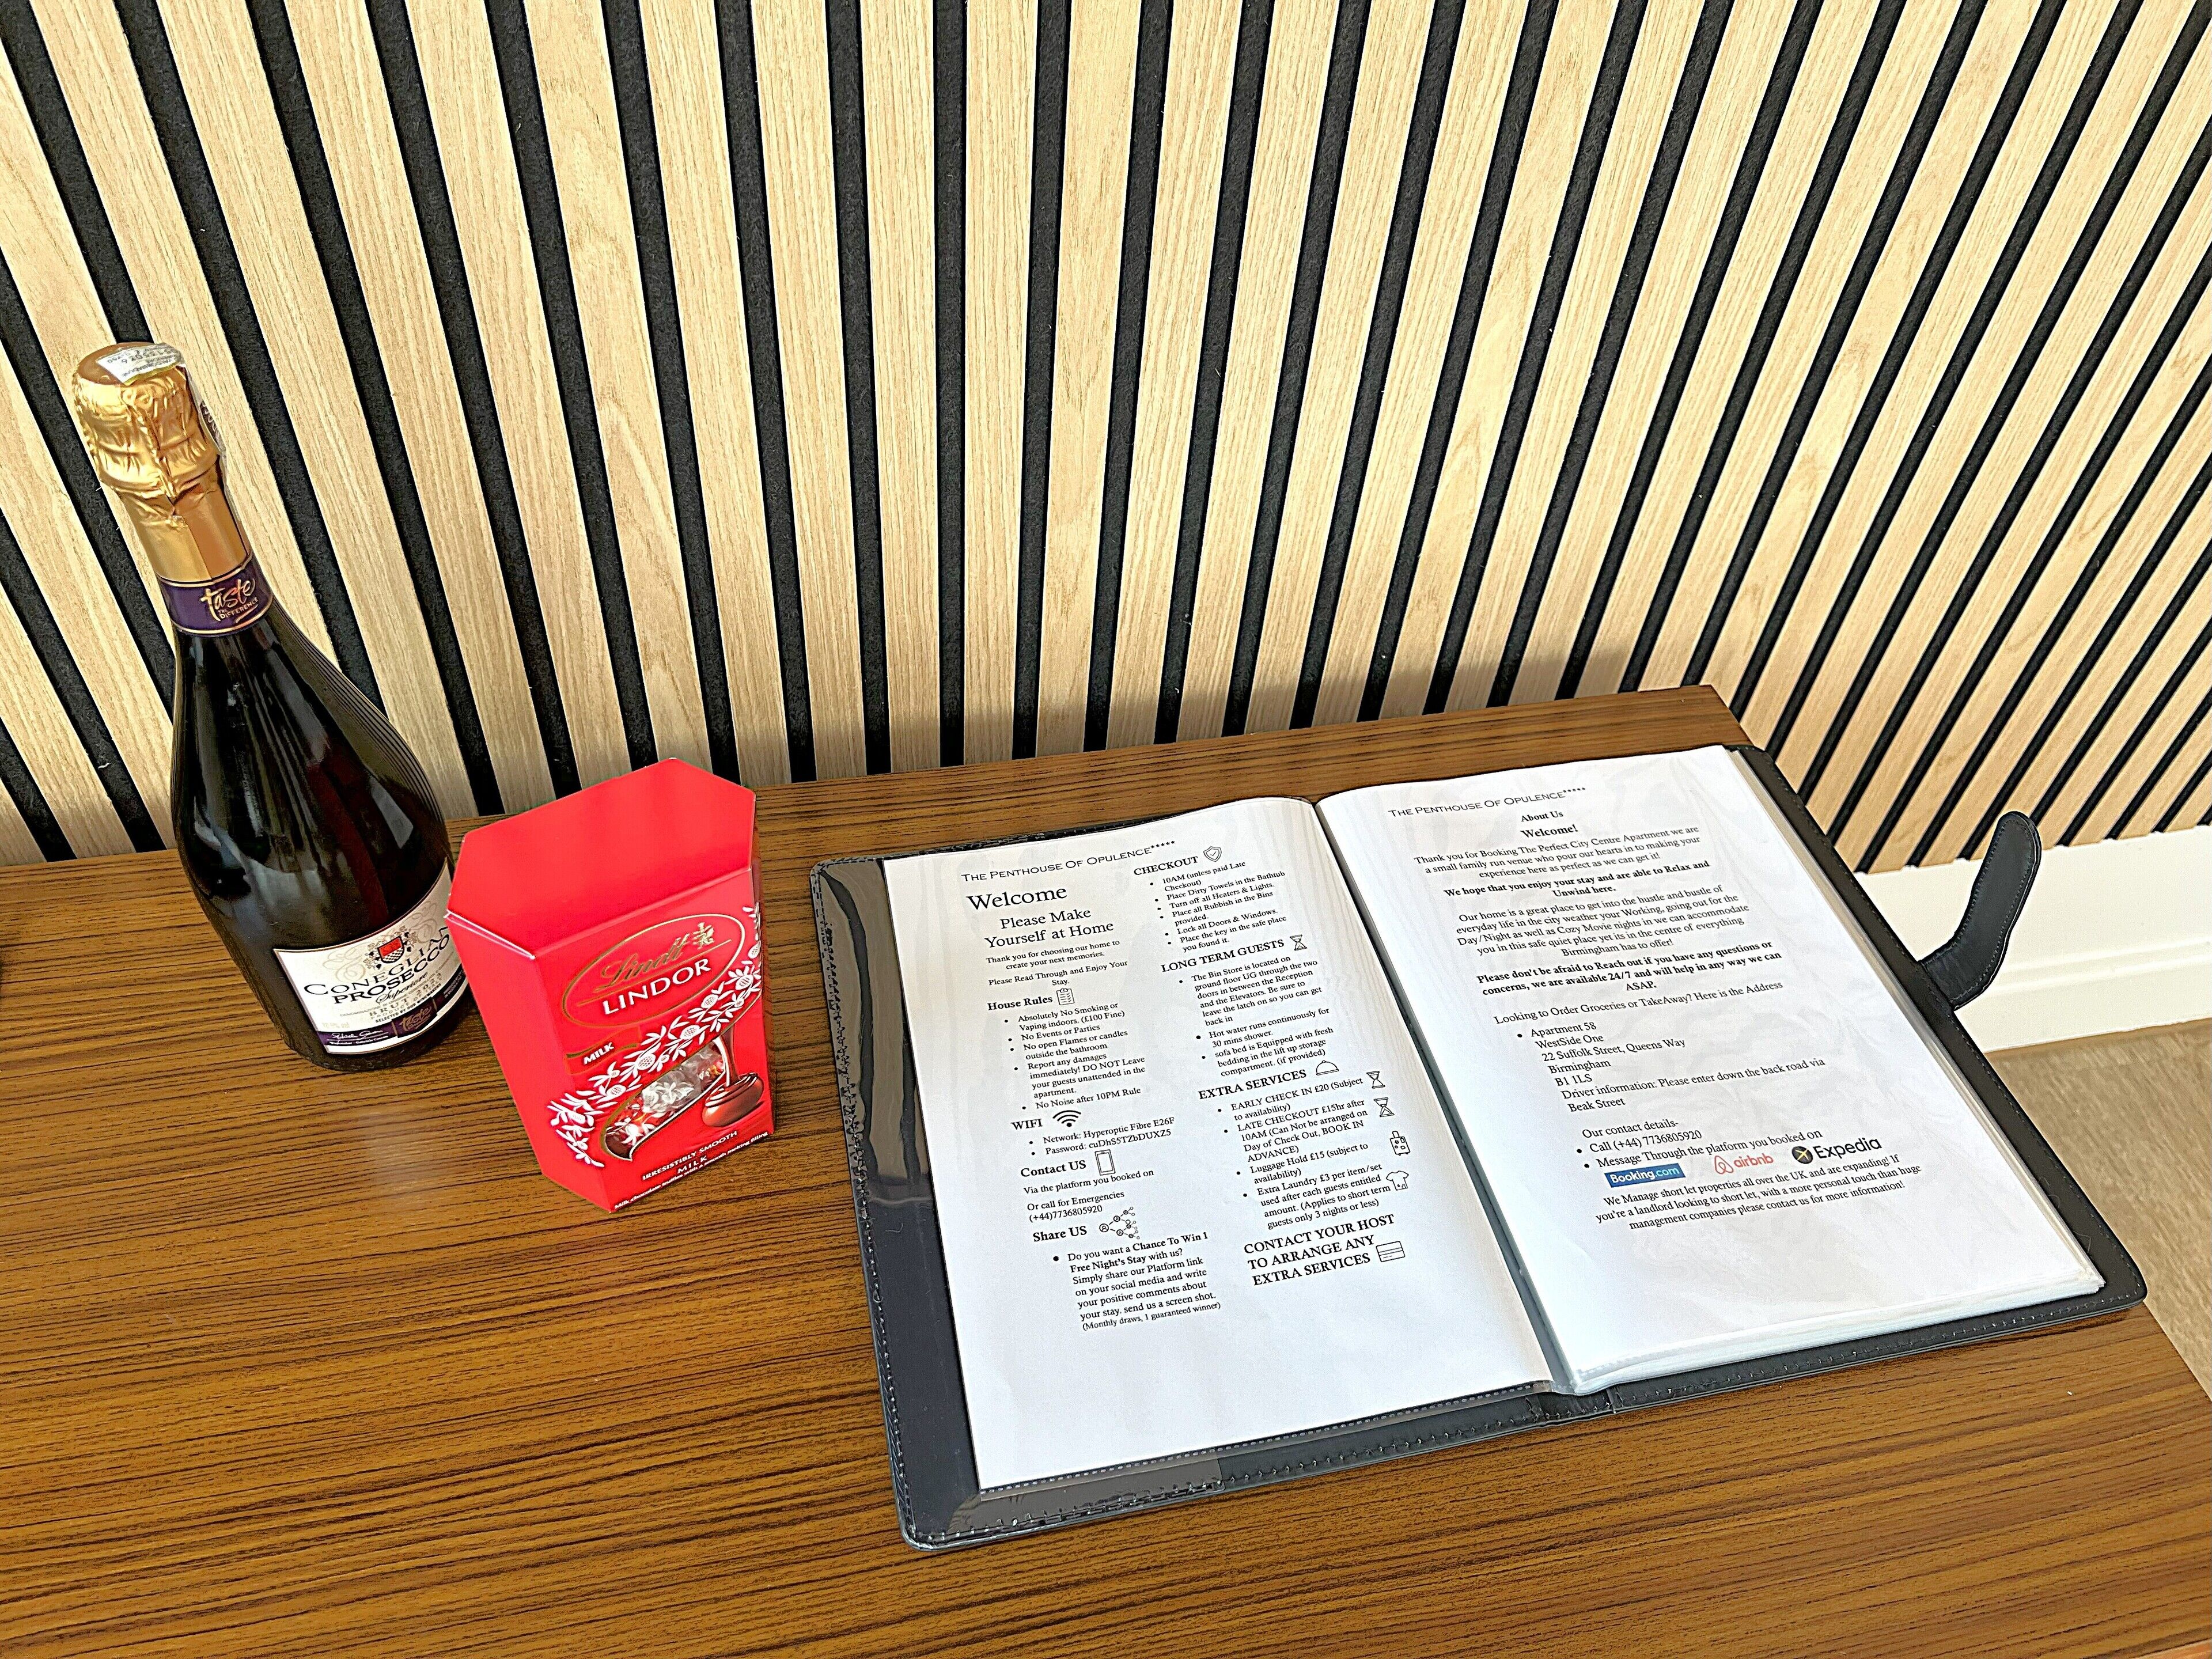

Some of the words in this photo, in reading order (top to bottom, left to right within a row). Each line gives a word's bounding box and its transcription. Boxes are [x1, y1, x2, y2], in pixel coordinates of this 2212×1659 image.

[200, 578, 256, 622] taste
[220, 597, 259, 619] DIFFERENCE
[1388, 809, 1413, 817] THE
[1414, 802, 1482, 813] PENTHOUSE
[1521, 813, 1549, 821] About
[1520, 824, 1578, 838] Welcome!
[1413, 854, 1445, 863] Thank
[1446, 853, 1464, 862] you
[1479, 848, 1518, 857] Booking
[1518, 846, 1537, 854] The
[1537, 843, 1569, 851] Perfect
[1623, 830, 1670, 842] Apartment
[961, 873, 987, 881] THE
[990, 863, 1063, 878] PENTHOUSE
[1065, 860, 1083, 868] OF
[1134, 856, 1198, 875] CHECKOUT
[965, 888, 1067, 910] Welcome
[1552, 887, 1590, 897] Unwind
[1592, 885, 1616, 895] here.
[999, 916, 1046, 929] Please
[1048, 909, 1091, 922] Make
[984, 929, 1046, 948] Yourself
[1051, 929, 1066, 939] at
[1068, 923, 1113, 937] Home
[986, 955, 1010, 963] Thank
[1040, 947, 1074, 956] choosing
[1160, 958, 1196, 972] LONG
[1199, 949, 1236, 964] TERM
[1237, 939, 1284, 955] GUESTS
[1560, 945, 1619, 956] Birmingham
[1649, 938, 1673, 948] offer!
[332, 934, 450, 1005] PROSECCO
[594, 933, 690, 993] Lindt
[603, 959, 711, 1015] LINDOR
[1626, 980, 1656, 990] ASAP.
[369, 997, 409, 1016] BRUT
[987, 1001, 1021, 1010] House
[1023, 996, 1052, 1006] Rules
[376, 1012, 399, 1023] SELECTED
[1531, 1024, 1583, 1037] Apartment
[1584, 1021, 1596, 1030] 58
[1534, 1036, 1581, 1048] WestSide
[1582, 1035, 1604, 1043] One
[1541, 1052, 1555, 1061] 22
[1556, 1048, 1593, 1059] Suffolk
[1593, 1046, 1625, 1055] Street,
[1626, 1042, 1662, 1053] Queens
[1662, 1039, 1685, 1048] Way
[583, 1042, 615, 1065] MILK
[1547, 1060, 1611, 1073] Birmingham
[1198, 1084, 1244, 1099] EXTRA
[1245, 1069, 1306, 1090] SERVICES
[1554, 1077, 1569, 1086] B1
[1571, 1073, 1592, 1084] 1LS
[1230, 1097, 1262, 1110] EARLY
[1265, 1090, 1300, 1103] CHECK
[1300, 1087, 1312, 1095] IN
[1315, 1084, 1329, 1092] £20
[1331, 1078, 1363, 1090] (Subject
[1237, 1120, 1263, 1131] LATE
[1264, 1107, 1319, 1125] CHECKOUT
[1321, 1103, 1344, 1113] £15hr
[1346, 1100, 1364, 1108] after
[1567, 1101, 1595, 1112] Beak
[1595, 1098, 1626, 1108] Street
[1010, 1118, 1043, 1130] WIFI
[1043, 1132, 1081, 1143] Network:
[1082, 1126, 1128, 1138] Hyperoptic
[1129, 1122, 1151, 1130] Fibre
[1152, 1116, 1174, 1127] E26F
[1582, 1129, 1603, 1138] Our
[1605, 1123, 1642, 1135] contact
[1643, 1119, 1678, 1130] details-
[1045, 1142, 1086, 1154] Password:
[1089, 1128, 1171, 1148] cuDhS5TZbDUXZ5
[1589, 1141, 1612, 1152] Call
[1613, 1137, 1642, 1150] (+44)
[1642, 1130, 1702, 1145] 7736805920
[642, 1151, 697, 1180] IRRESISTIBLY
[699, 1130, 737, 1153] SMOOTH
[1248, 1145, 1298, 1162] ADVANCE)
[1249, 1161, 1285, 1173] Luggage
[1286, 1154, 1308, 1165] Hold
[1310, 1150, 1324, 1160] £15
[1326, 1145, 1358, 1157] (subject
[1609, 1166, 1680, 1185] Booking.com
[1733, 1153, 1774, 1169] airbnb
[1813, 1137, 1883, 1159] Expedia
[614, 1199, 630, 1210] Milk
[630, 1184, 662, 1201] chocolate
[704, 1152, 726, 1166] smooth
[727, 1139, 751, 1154] melting
[751, 1131, 769, 1144] filling
[677, 1155, 708, 1174] MILK
[1020, 1164, 1066, 1177] Contact
[1067, 1160, 1086, 1170] US
[1055, 1180, 1091, 1192] platform
[1092, 1177, 1109, 1186] you
[1110, 1171, 1141, 1181] booked
[1029, 1205, 1102, 1222] (+44)7736805920
[1032, 1231, 1066, 1241] Share
[1068, 1225, 1087, 1236] US
[1244, 1231, 1311, 1253] CONTACT
[1314, 1223, 1356, 1239] YOUR
[1356, 1214, 1393, 1230] HOST
[1069, 1264, 1090, 1272] Free
[1091, 1258, 1125, 1269] Night's
[1127, 1256, 1146, 1264] Stay
[1148, 1251, 1168, 1260] with
[1169, 1248, 1182, 1256] us?
[1247, 1257, 1267, 1269] TO
[1271, 1242, 1342, 1265] ARRANGE
[1345, 1234, 1374, 1250] ANY
[1252, 1267, 1302, 1285] EXTRA
[1304, 1252, 1370, 1275] SERVICES
